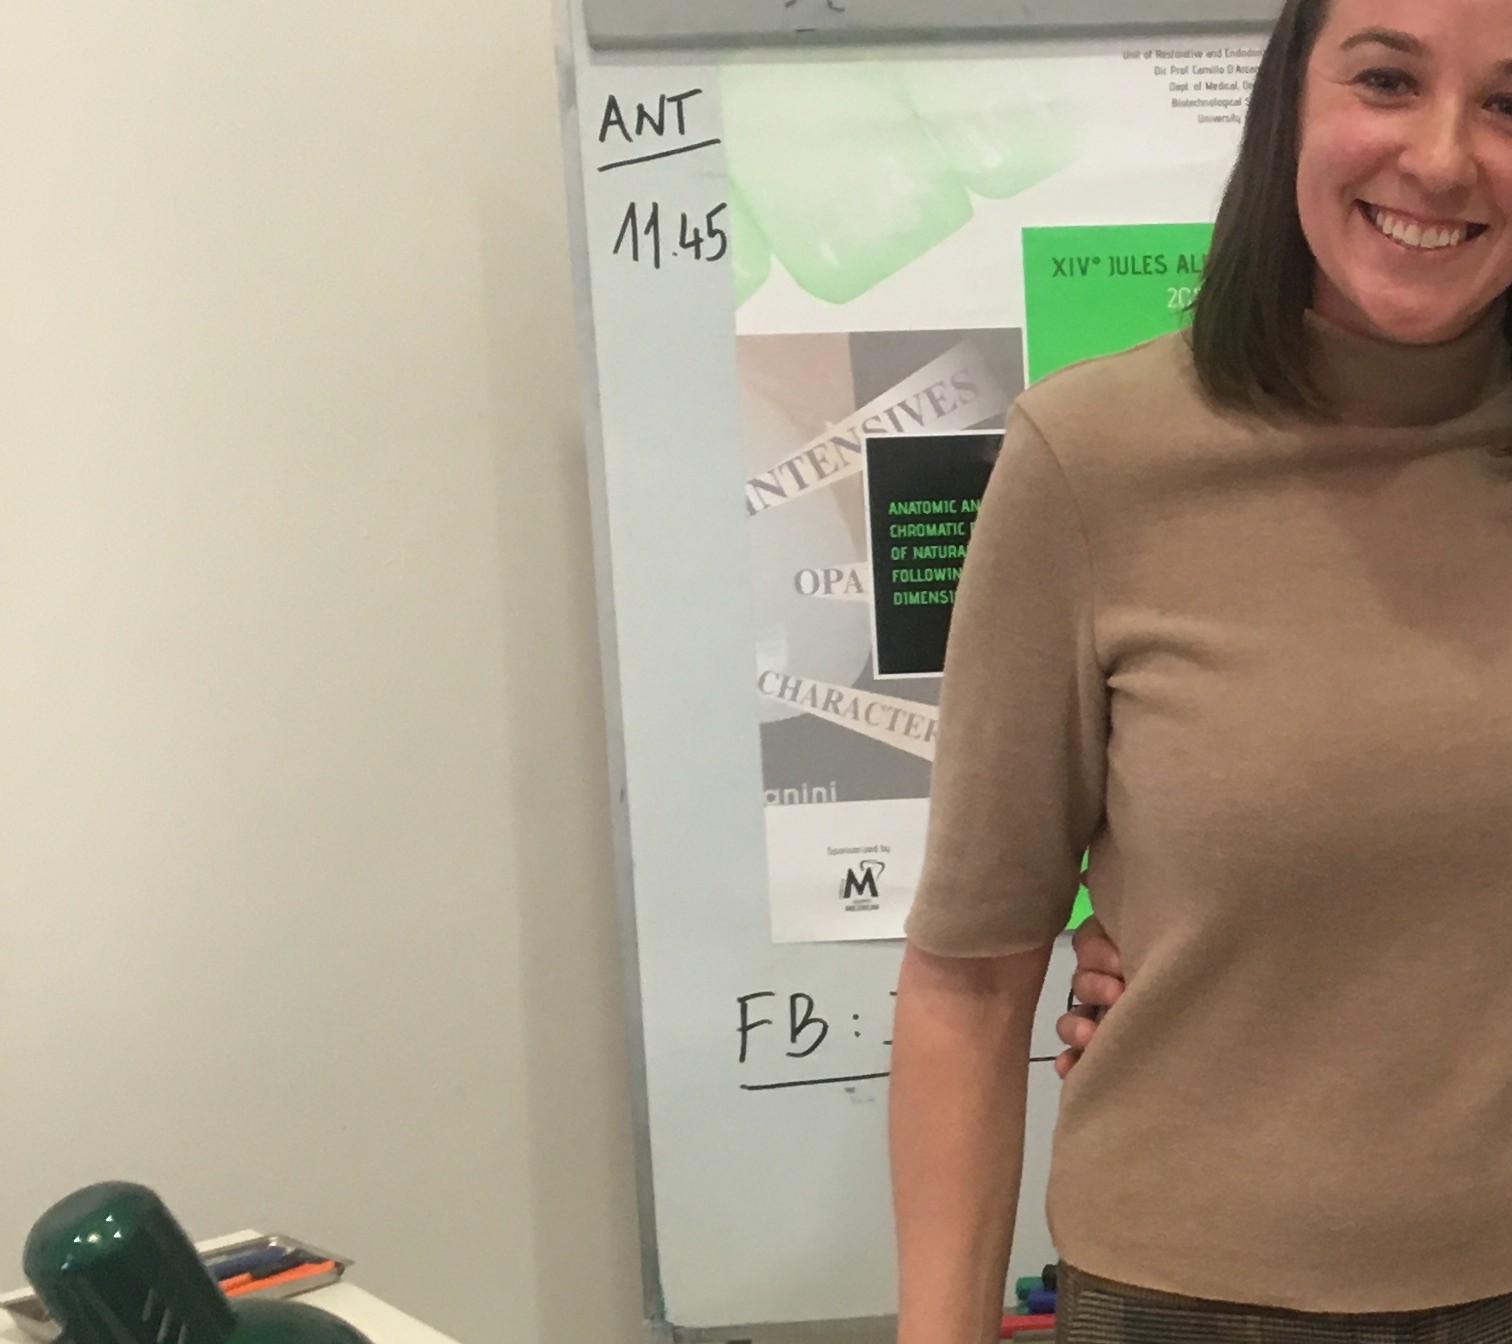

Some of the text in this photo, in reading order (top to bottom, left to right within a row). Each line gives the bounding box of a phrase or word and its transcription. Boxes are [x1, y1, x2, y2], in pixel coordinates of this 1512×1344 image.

[1205, 49, 1222, 58] and
[599, 88, 703, 143] ANT
[612, 201, 728, 270] 11.45
[1108, 254, 1168, 277] JULES
[888, 499, 958, 515] ANATOMIC
[889, 522, 967, 538] CHROMATIC
[890, 546, 908, 560] OF
